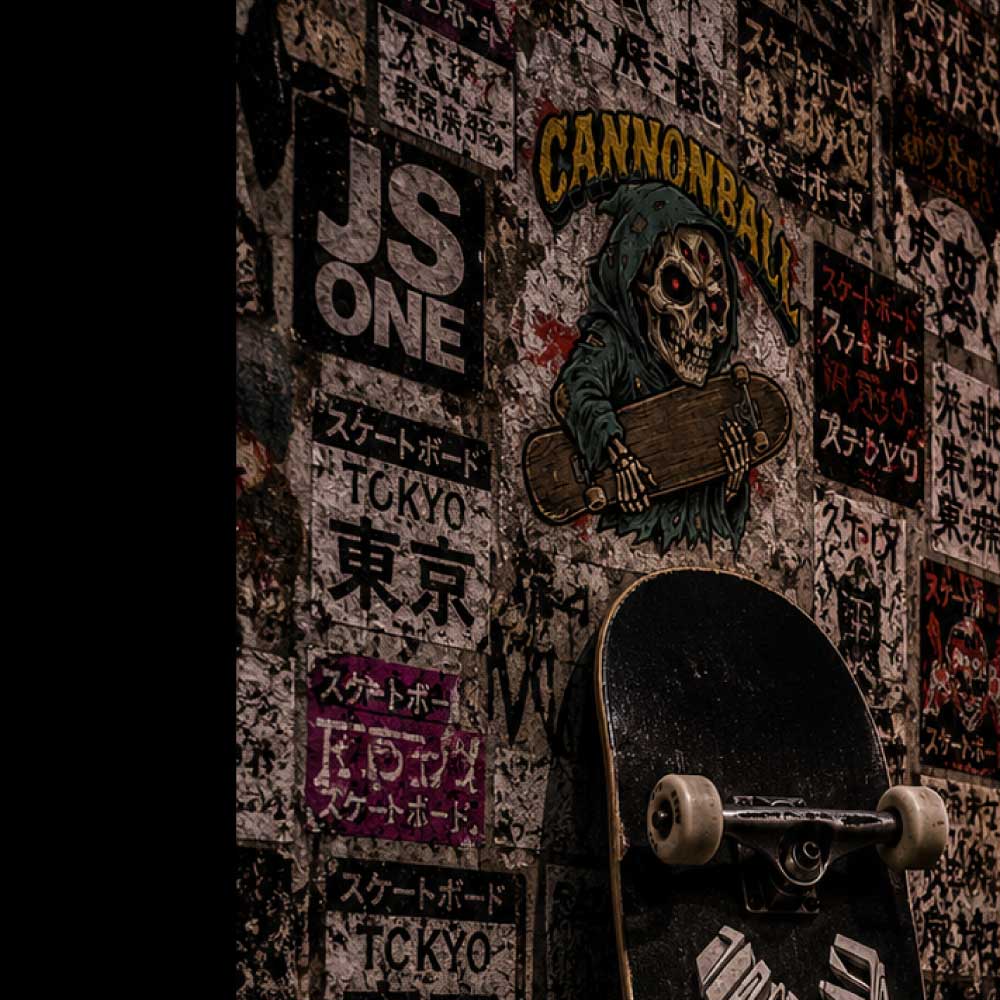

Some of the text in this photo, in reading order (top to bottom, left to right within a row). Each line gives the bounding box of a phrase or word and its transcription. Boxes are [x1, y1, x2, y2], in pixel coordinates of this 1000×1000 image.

[316, 136, 465, 297] JS
[536, 111, 799, 338] CANNONBALL
[314, 260, 466, 375] ONE
[326, 401, 487, 479] スケートボード
[326, 516, 477, 628] 東京
[339, 871, 506, 917] スケートボード
